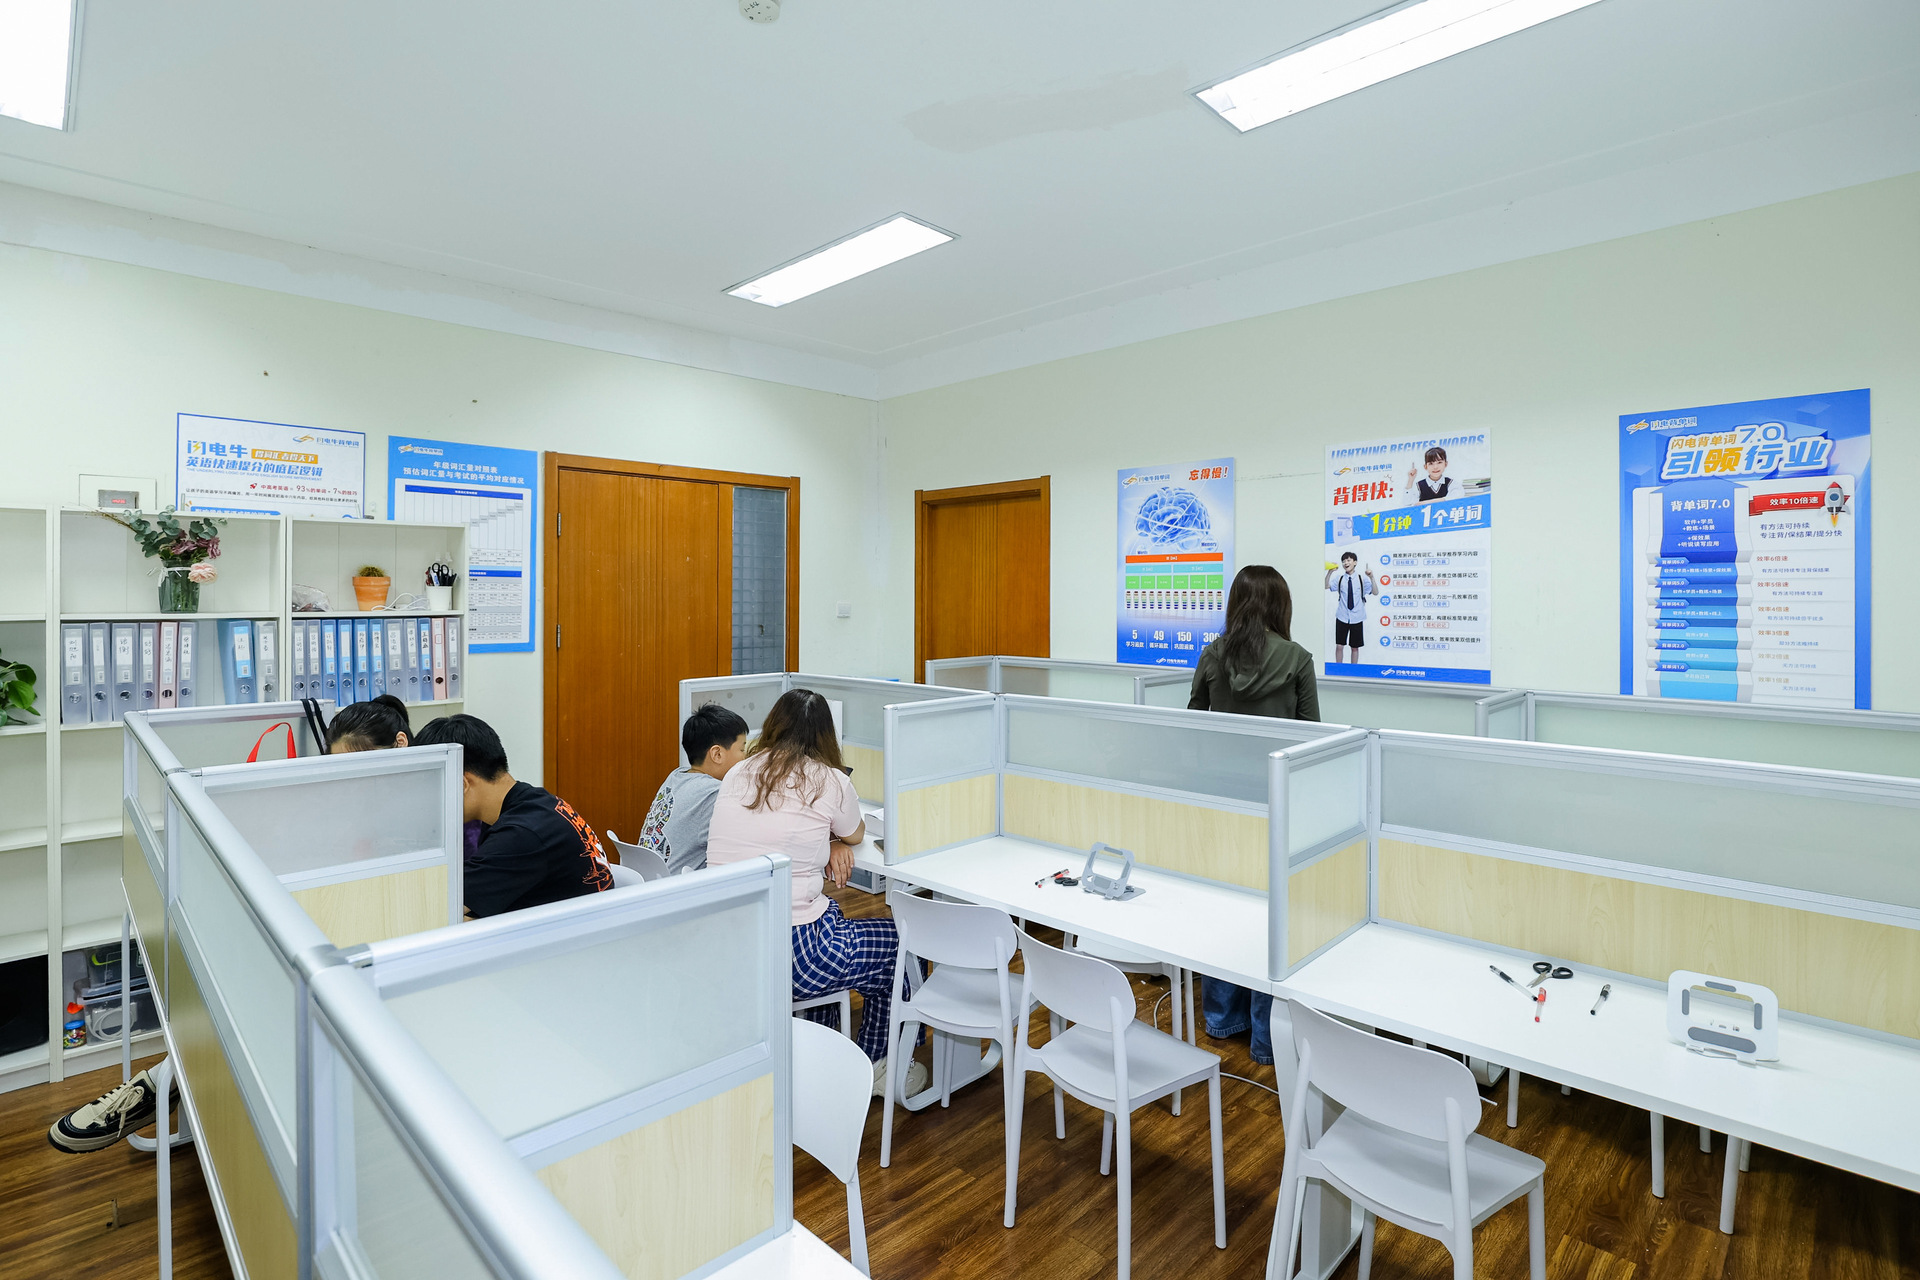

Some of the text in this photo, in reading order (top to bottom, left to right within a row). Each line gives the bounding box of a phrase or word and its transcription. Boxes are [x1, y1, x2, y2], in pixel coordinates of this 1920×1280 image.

[188, 440, 248, 458] 闪电牛
[1331, 445, 1387, 458] LIGHTNING
[1439, 434, 1485, 448] WORDS
[1666, 440, 1828, 476] 引领行业
[186, 456, 322, 476] 英语快速提分的底层逻辑
[434, 461, 498, 474] 年级词汇量对照表
[403, 467, 524, 484] 预估词汇量与考试的平均对应情况
[1671, 499, 1730, 511] 背单词7.0
[1770, 496, 1818, 506] 效率10倍速
[1371, 504, 1482, 534] 1分钟 1个单词
[1760, 530, 1842, 538] 专注背/保结果/提分快
[1132, 630, 1137, 639] 5
[1154, 630, 1164, 640] 49
[1177, 632, 1192, 641] 150
